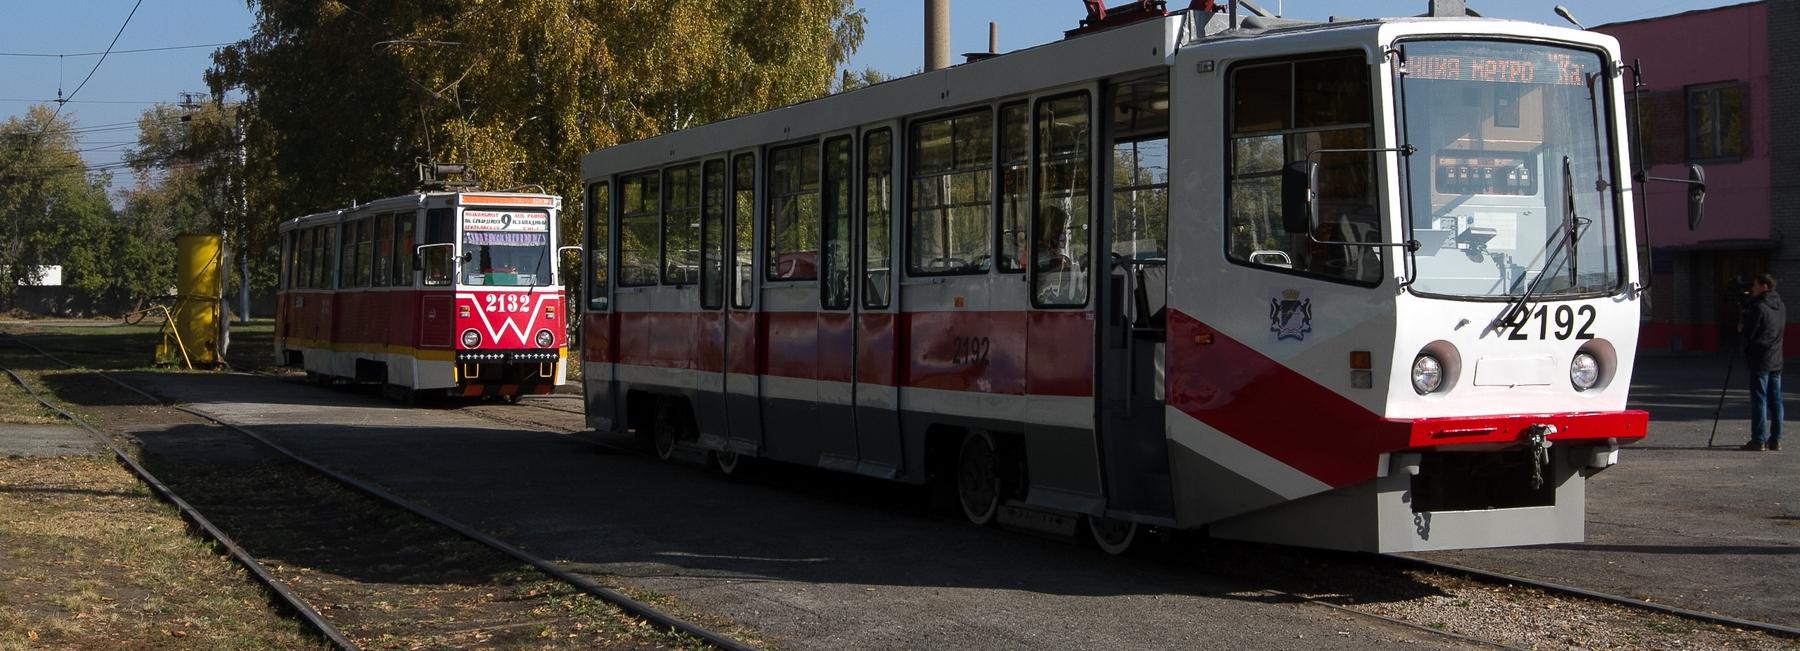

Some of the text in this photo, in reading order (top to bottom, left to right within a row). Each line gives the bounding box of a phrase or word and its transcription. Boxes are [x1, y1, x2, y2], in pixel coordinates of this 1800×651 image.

[501, 214, 512, 230] 9
[486, 293, 530, 312] 2132
[1508, 304, 1596, 340] 2192
[952, 335, 990, 365] 2192
